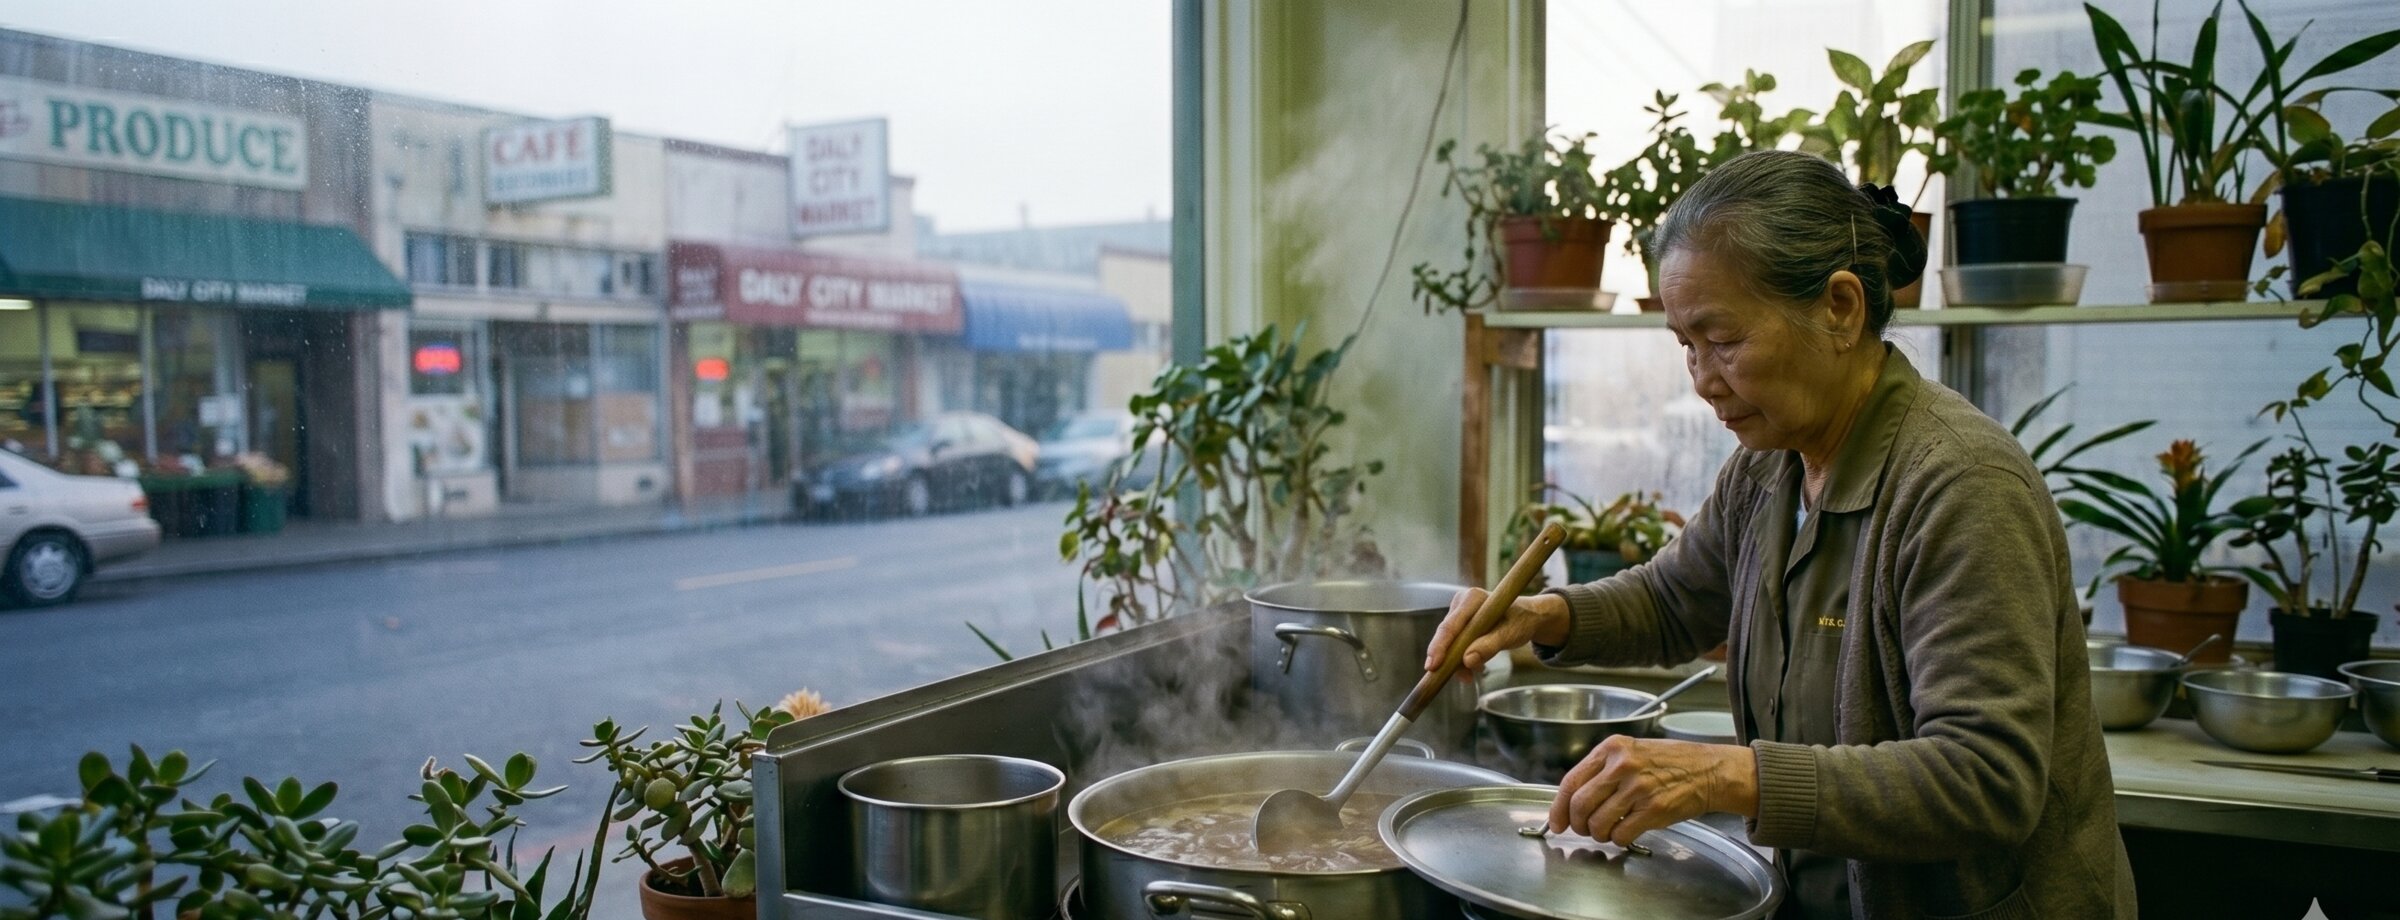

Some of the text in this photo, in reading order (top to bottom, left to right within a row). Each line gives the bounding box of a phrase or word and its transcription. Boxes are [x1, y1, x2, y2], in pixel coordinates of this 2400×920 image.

[48, 99, 298, 175] PRODUCE
[808, 165, 860, 194] CITY
[739, 268, 804, 306] DALY
[808, 274, 863, 309] CITY
